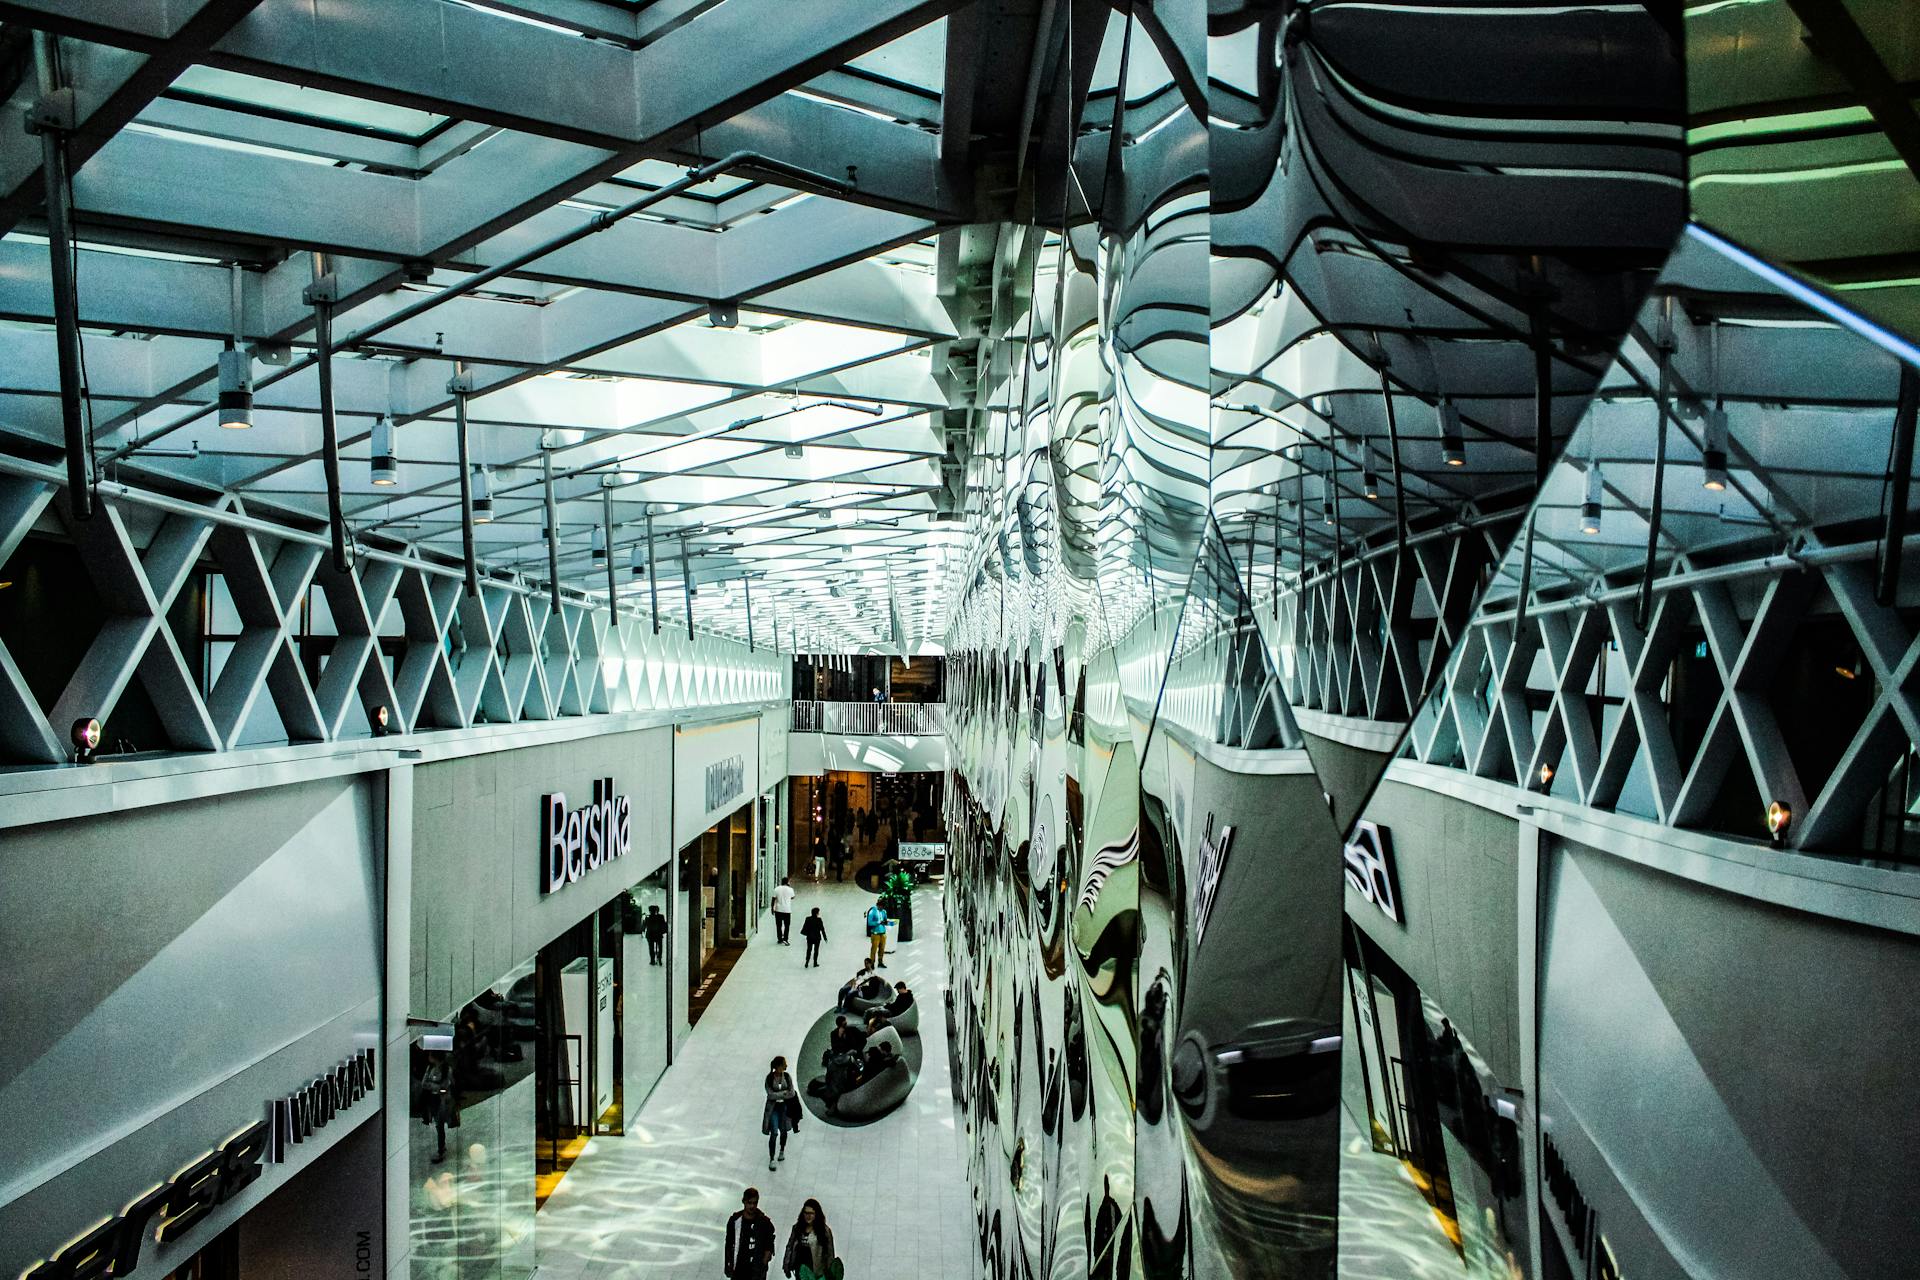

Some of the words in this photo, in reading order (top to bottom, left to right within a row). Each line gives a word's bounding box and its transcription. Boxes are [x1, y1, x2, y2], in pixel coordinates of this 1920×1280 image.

[545, 778, 631, 894] Bershka
[288, 1048, 375, 1144] WOMAN
[356, 1231, 370, 1280] .COM
